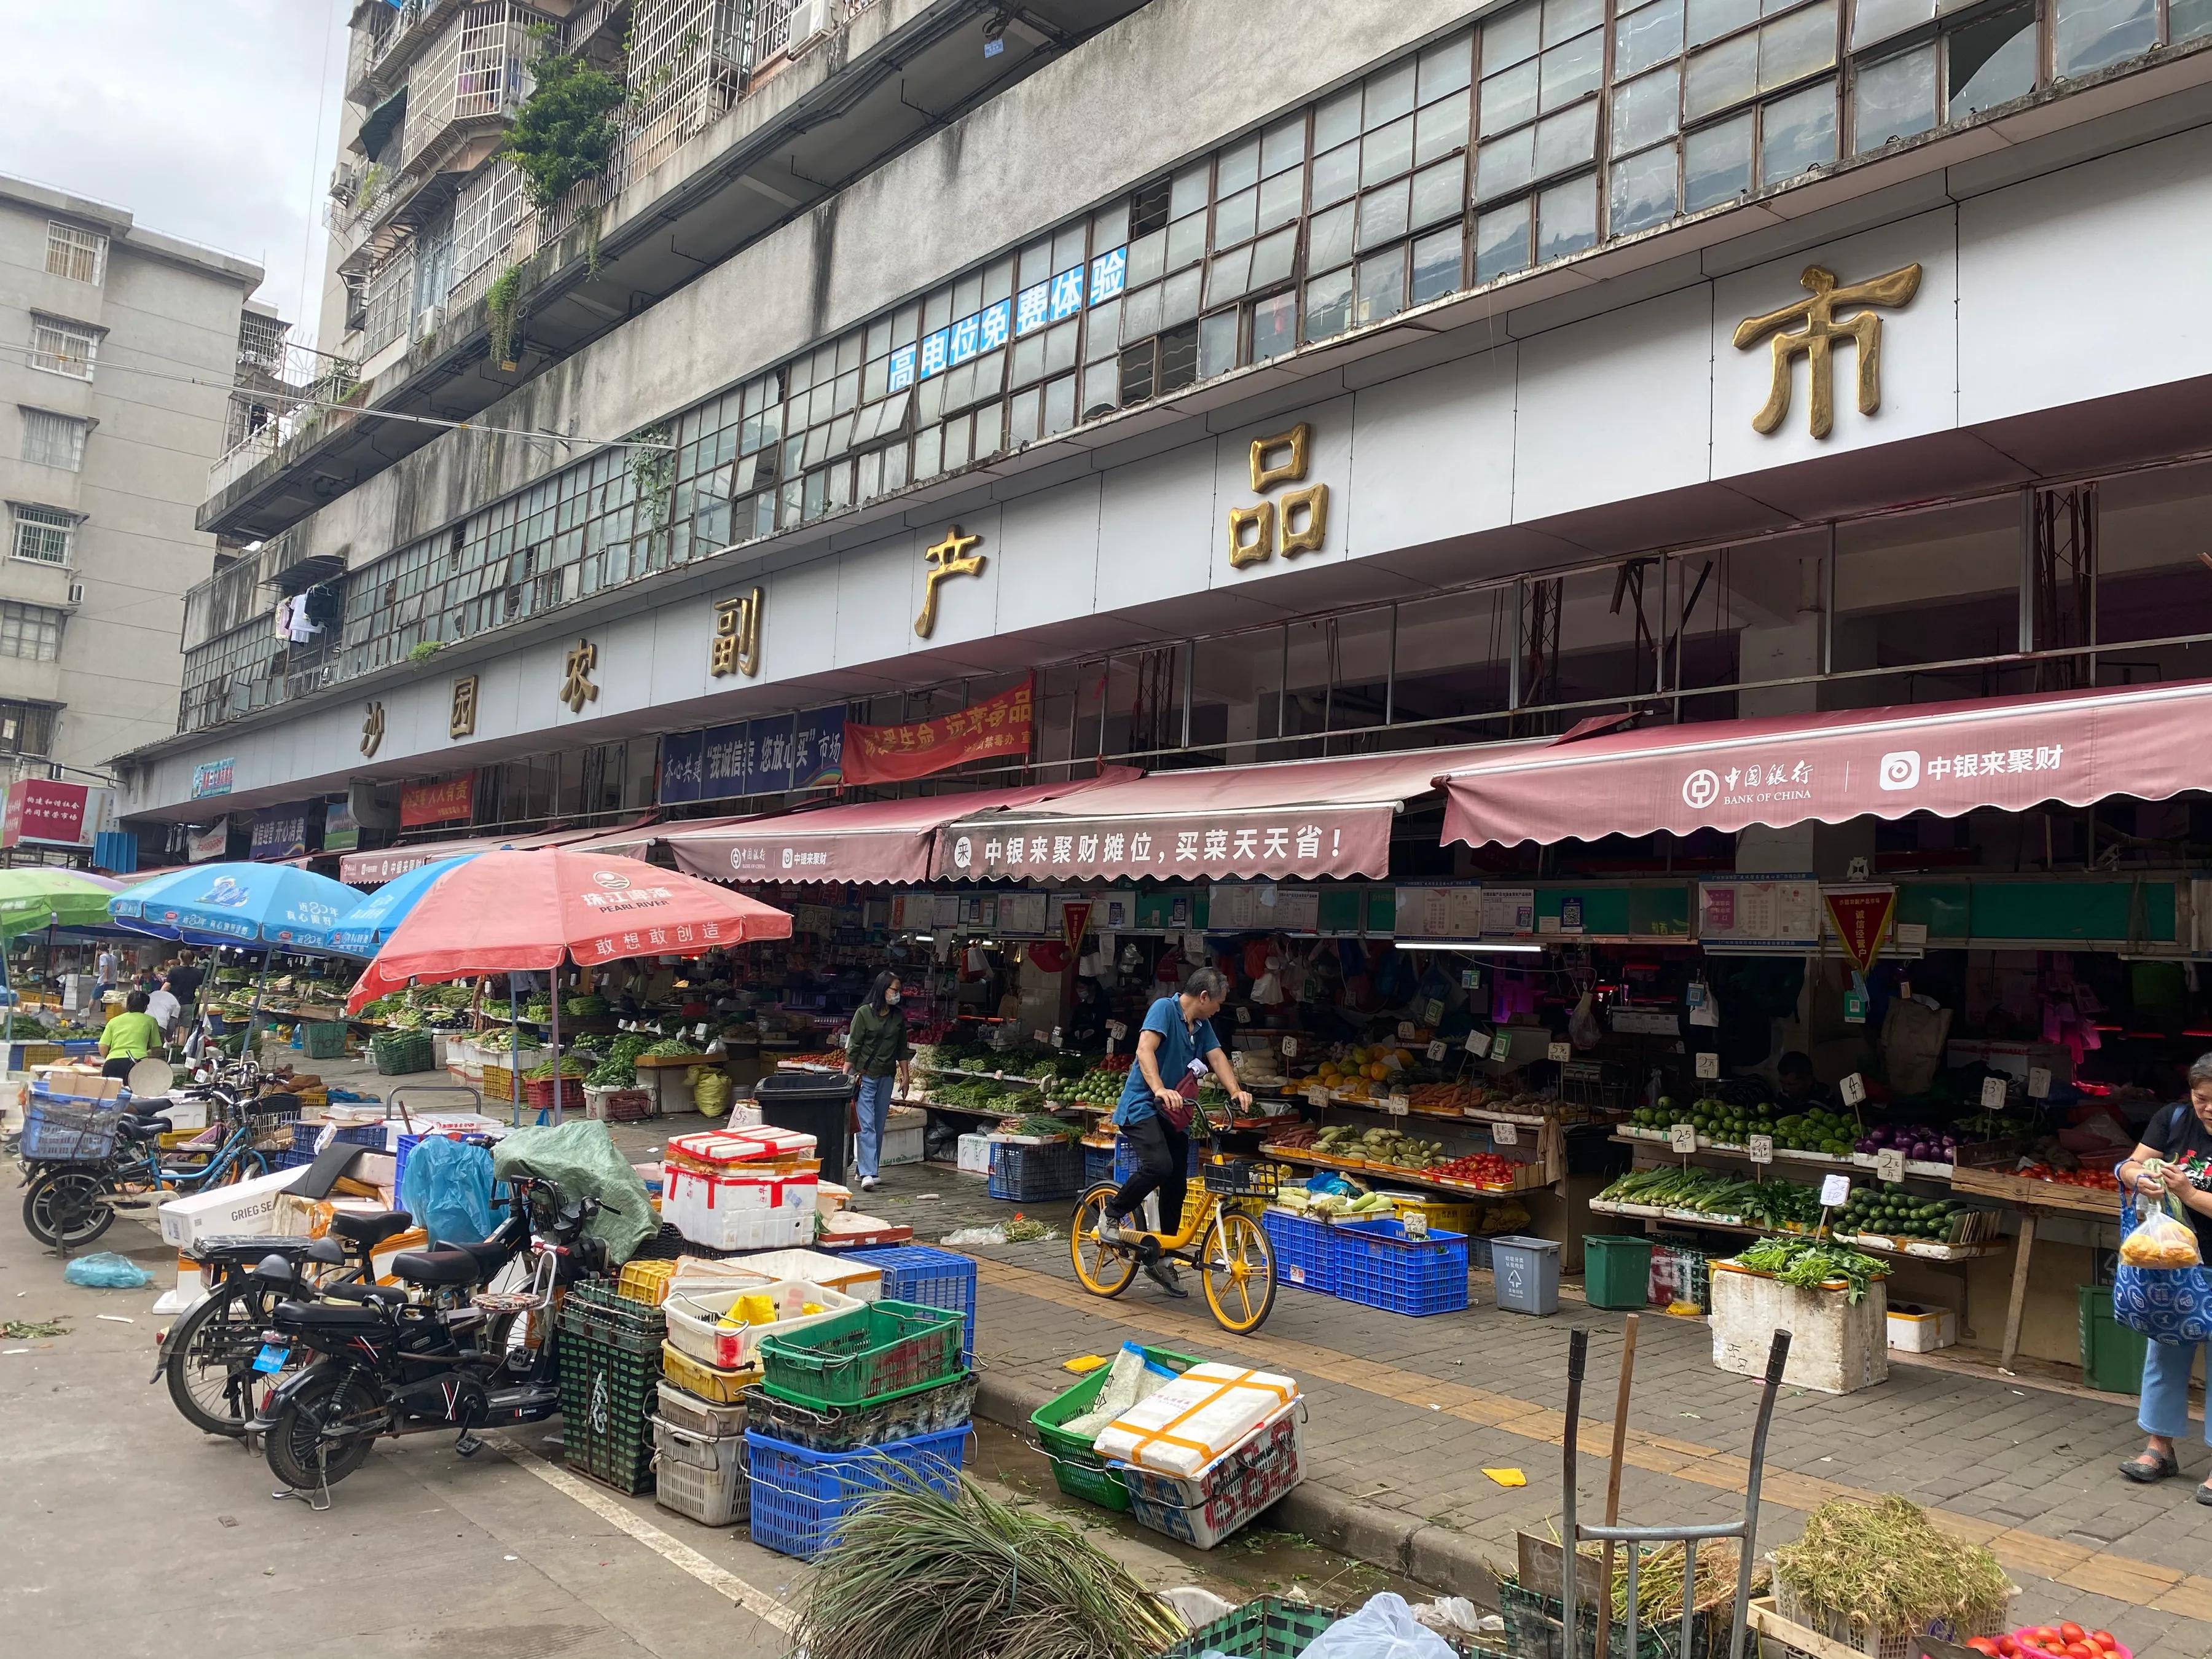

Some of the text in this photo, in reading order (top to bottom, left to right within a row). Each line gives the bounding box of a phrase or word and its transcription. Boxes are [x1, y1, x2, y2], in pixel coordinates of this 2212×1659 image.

[890, 249, 1125, 393] 高电位免费体验
[1928, 744, 2064, 780] 中银来聚财
[1724, 790, 1811, 805] BANK OF CHINA
[794, 852, 827, 866] 中银来聚财
[957, 841, 969, 861] 来
[581, 886, 673, 907] 珠江啤酒
[600, 900, 670, 913] PEARL RIVER
[595, 921, 720, 955] 敢想敢创造
[231, 1201, 275, 1222] GRIEG SE
